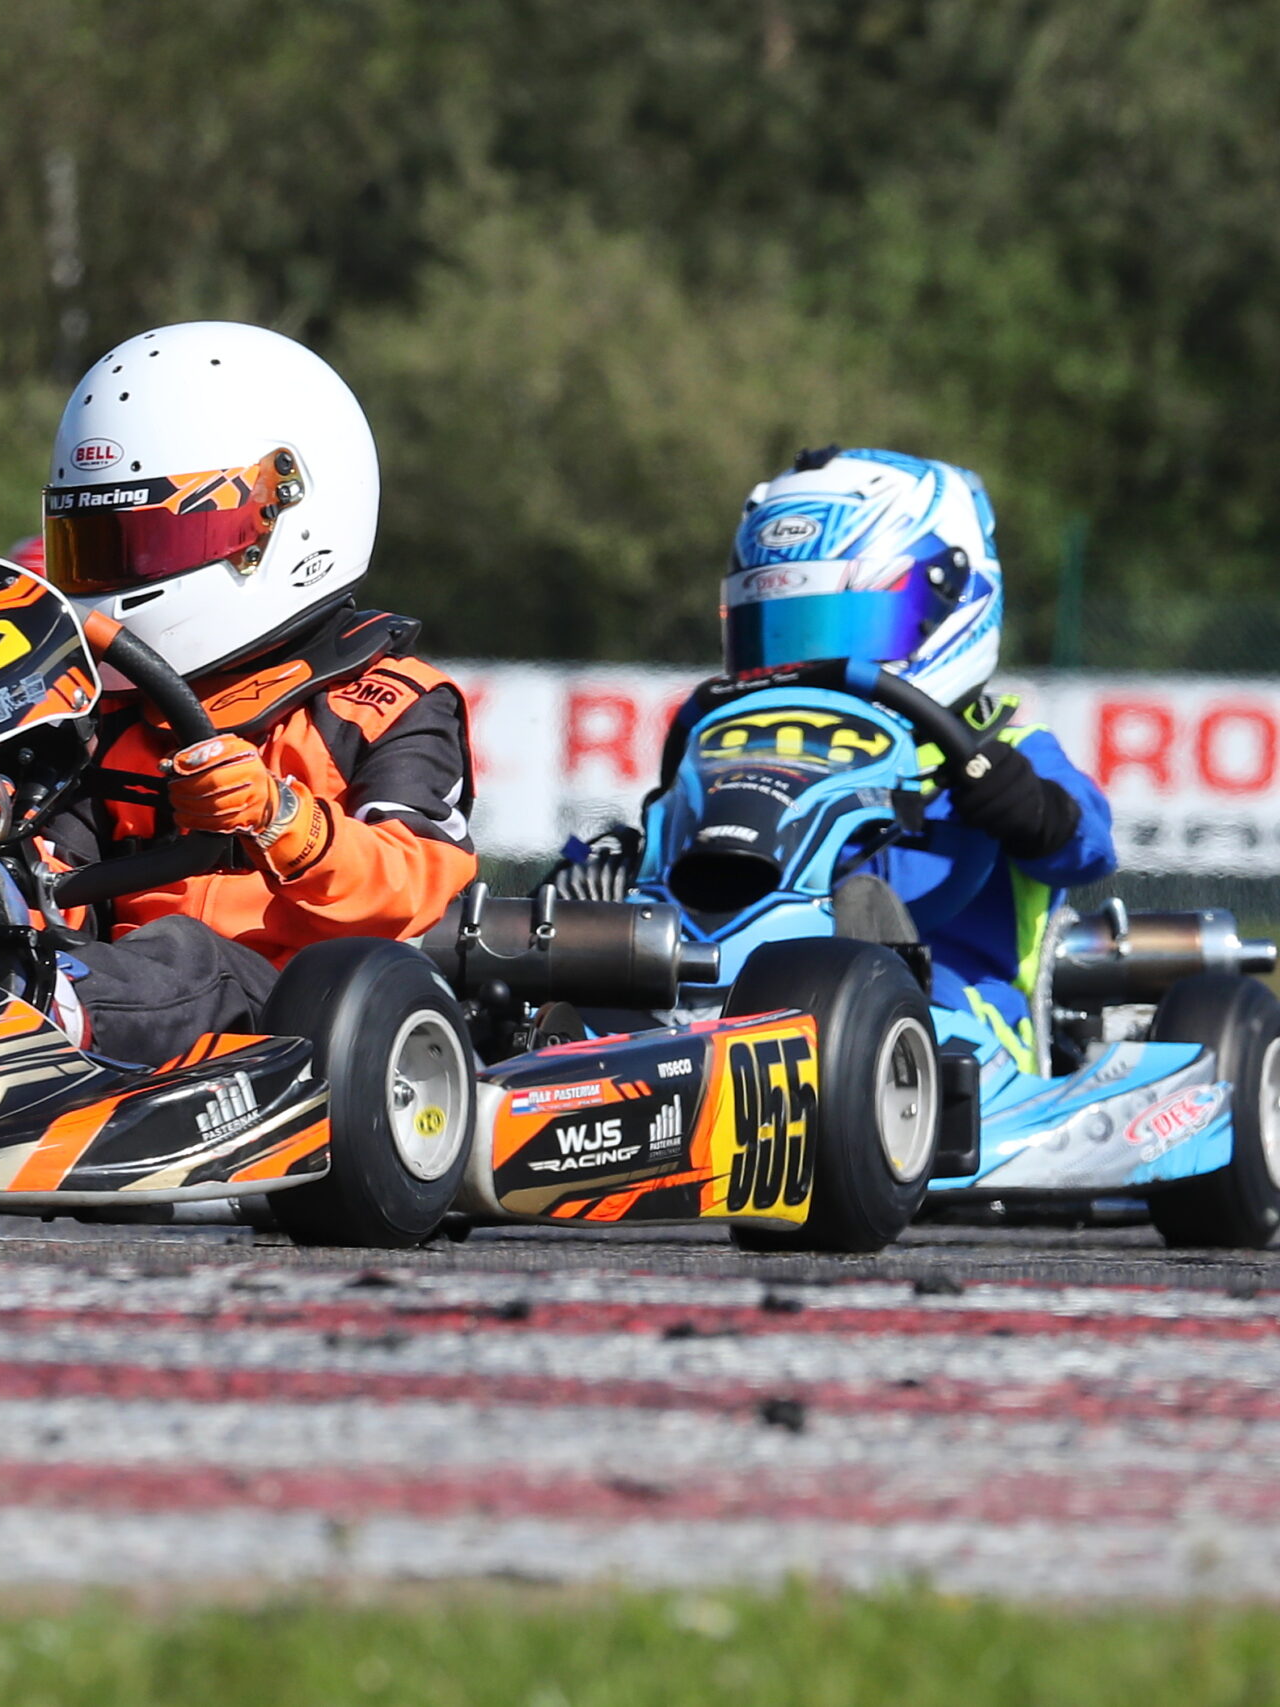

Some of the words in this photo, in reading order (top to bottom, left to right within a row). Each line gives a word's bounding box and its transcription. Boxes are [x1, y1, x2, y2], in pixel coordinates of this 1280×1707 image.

[76, 446, 115, 462] BELL
[78, 488, 150, 508] Racing
[202, 1109, 261, 1141] PASTERNAK
[555, 1118, 623, 1155] WJS
[726, 1036, 818, 1213] 955
[527, 1144, 643, 1172] RACING
